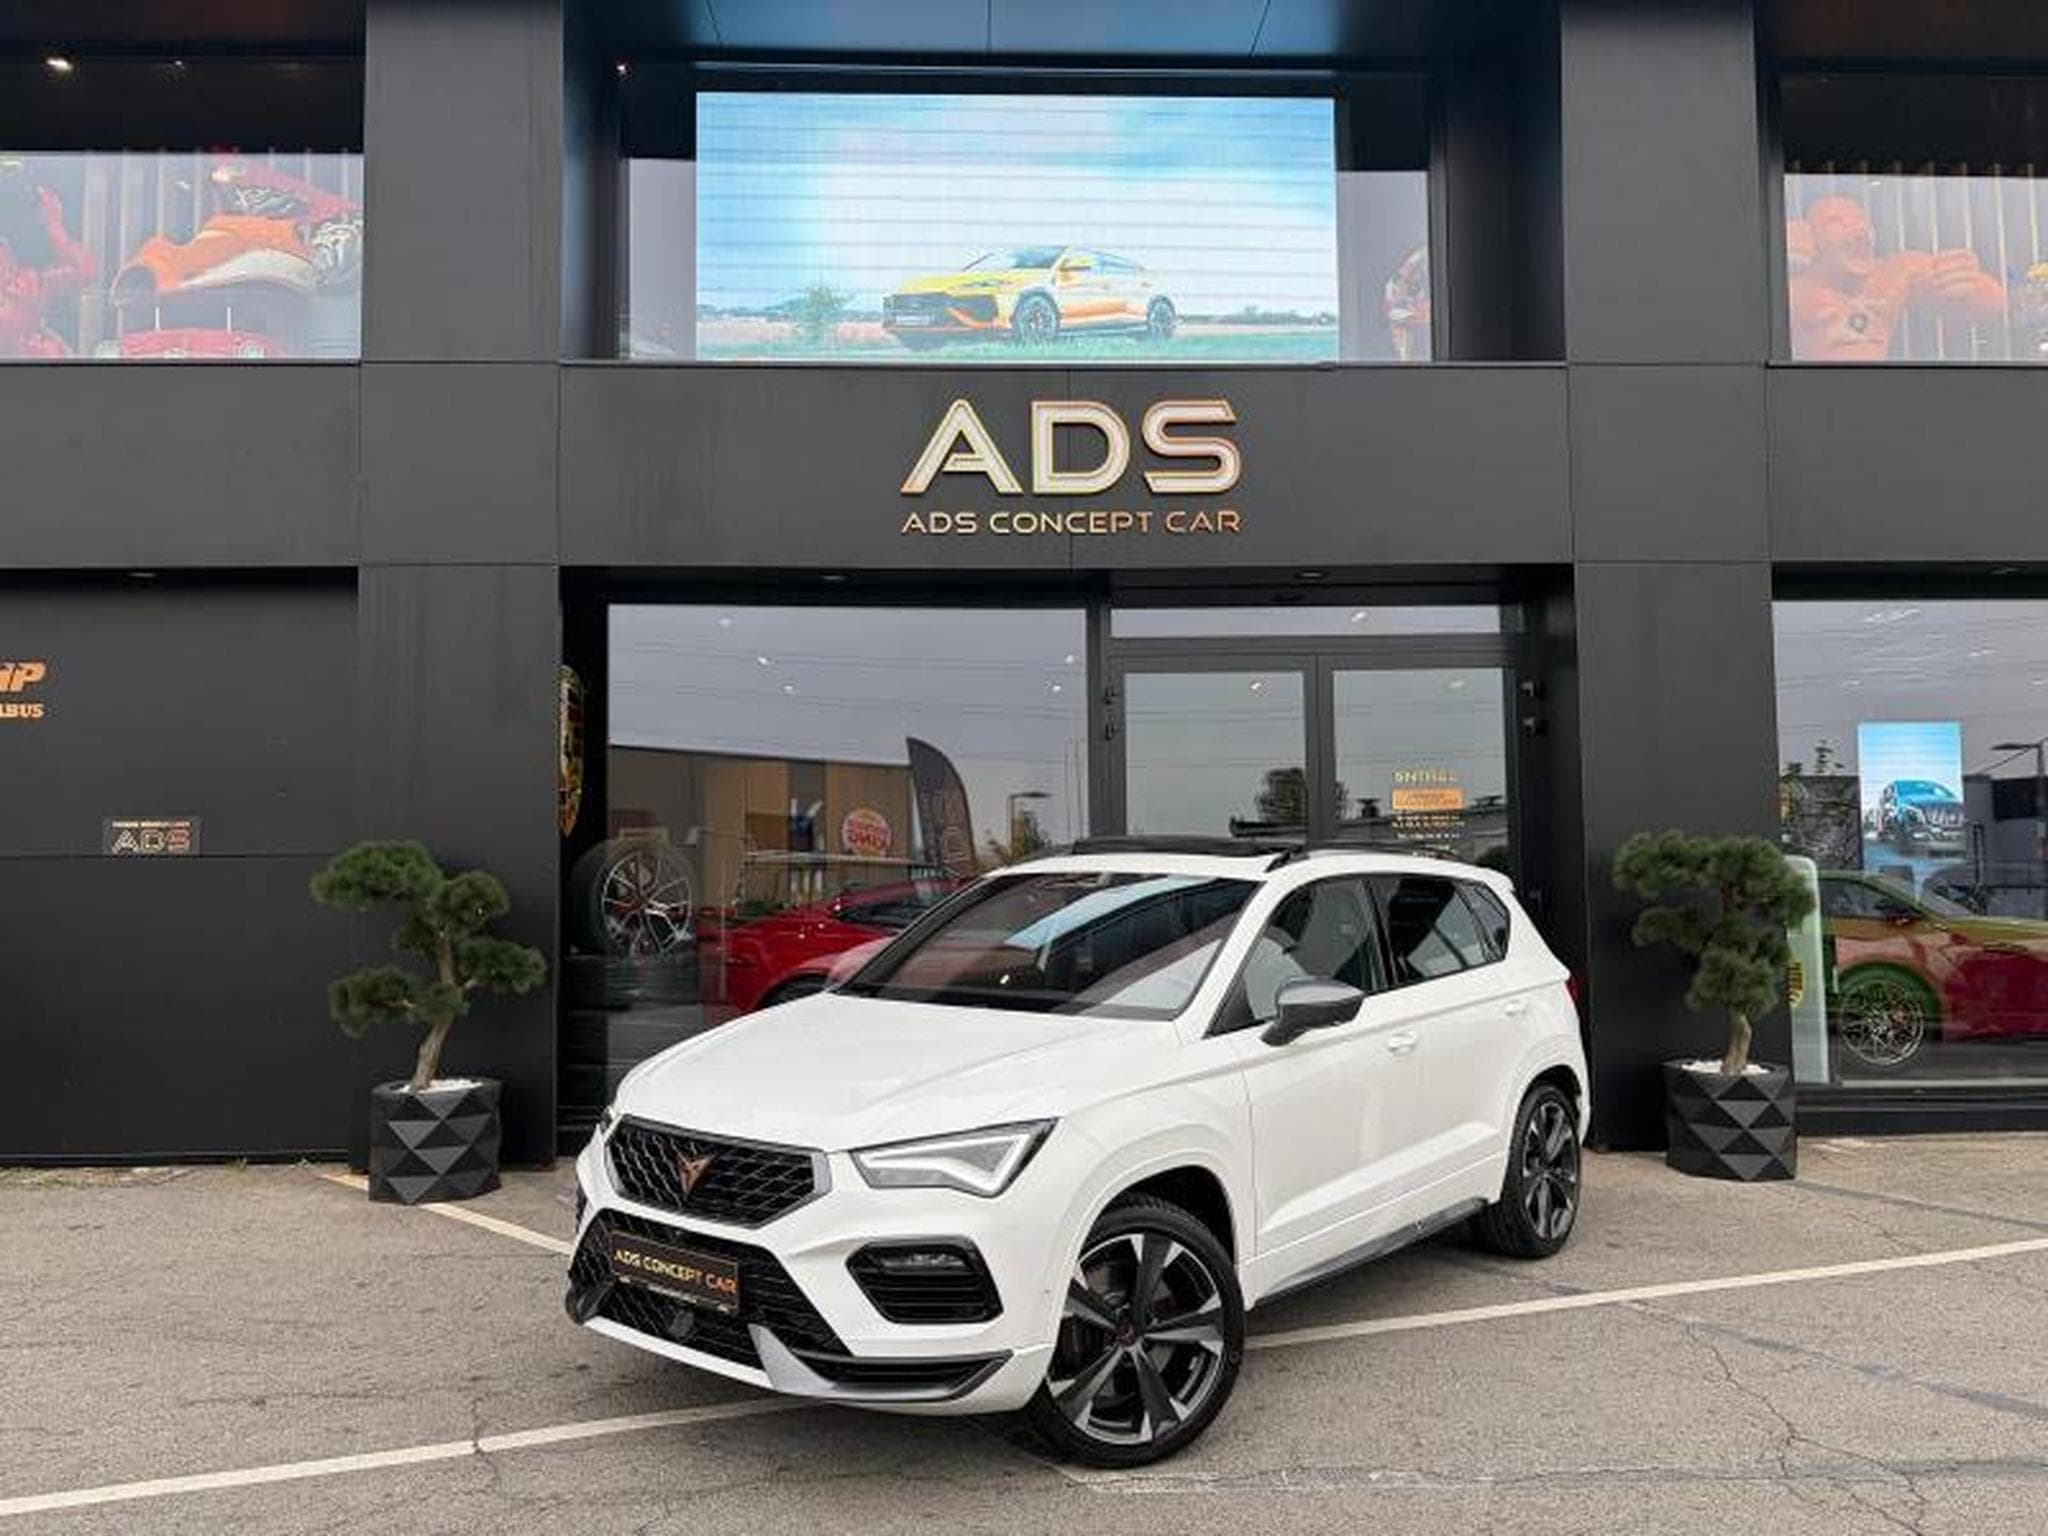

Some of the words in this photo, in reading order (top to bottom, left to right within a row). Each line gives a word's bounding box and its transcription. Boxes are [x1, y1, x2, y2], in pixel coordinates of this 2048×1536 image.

[900, 398, 1241, 494] ADS
[900, 512, 977, 534] ADS
[989, 511, 1153, 534] CONCEPT
[1164, 510, 1241, 533] CAR
[613, 1249, 641, 1268] ADS
[643, 1256, 702, 1284] CONCEPT
[705, 1273, 736, 1295] CAR
